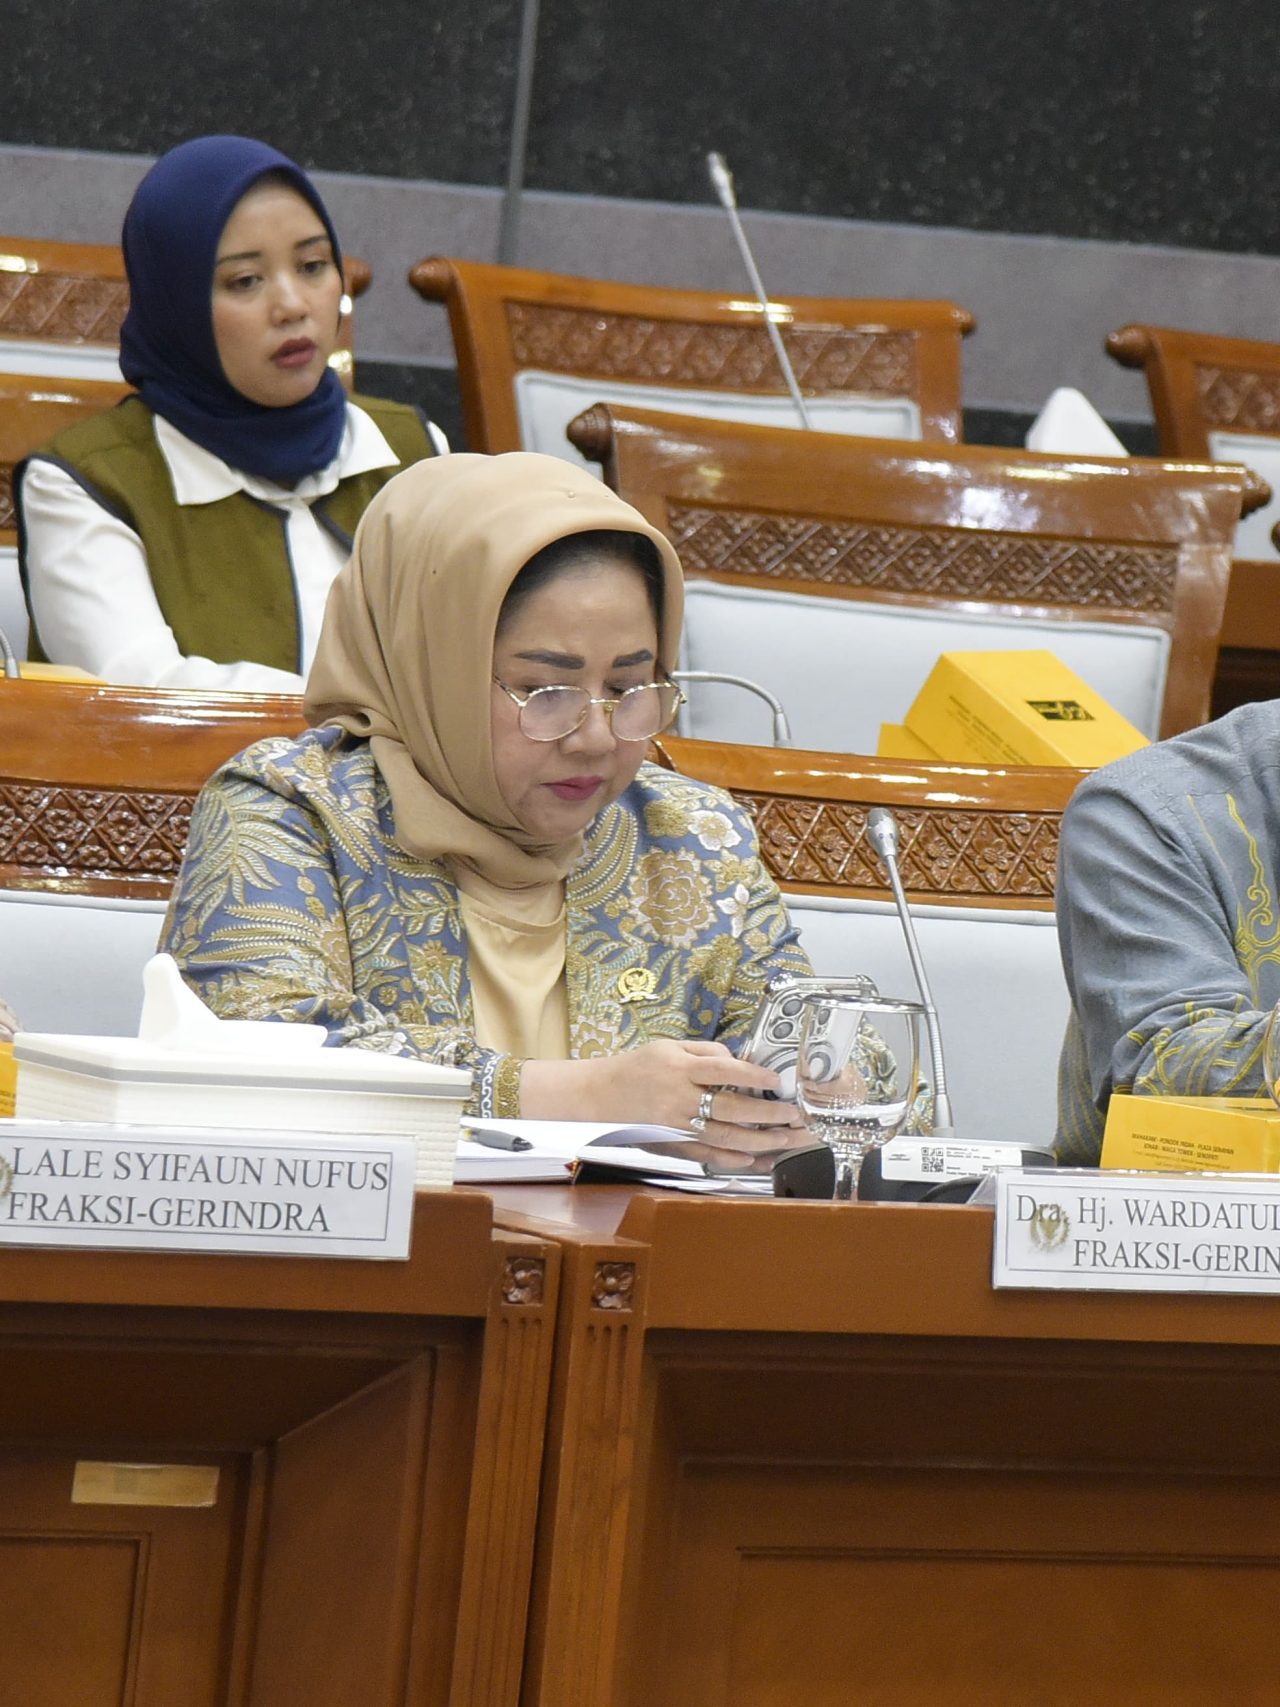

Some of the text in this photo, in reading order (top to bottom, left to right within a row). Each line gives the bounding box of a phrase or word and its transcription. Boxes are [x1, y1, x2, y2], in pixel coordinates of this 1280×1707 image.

[13, 1147, 389, 1191] LALE SYIFAUN NUFUS
[7, 1191, 331, 1233] FRAKSI-GERINDRA
[1077, 1197, 1114, 1233] Hj.
